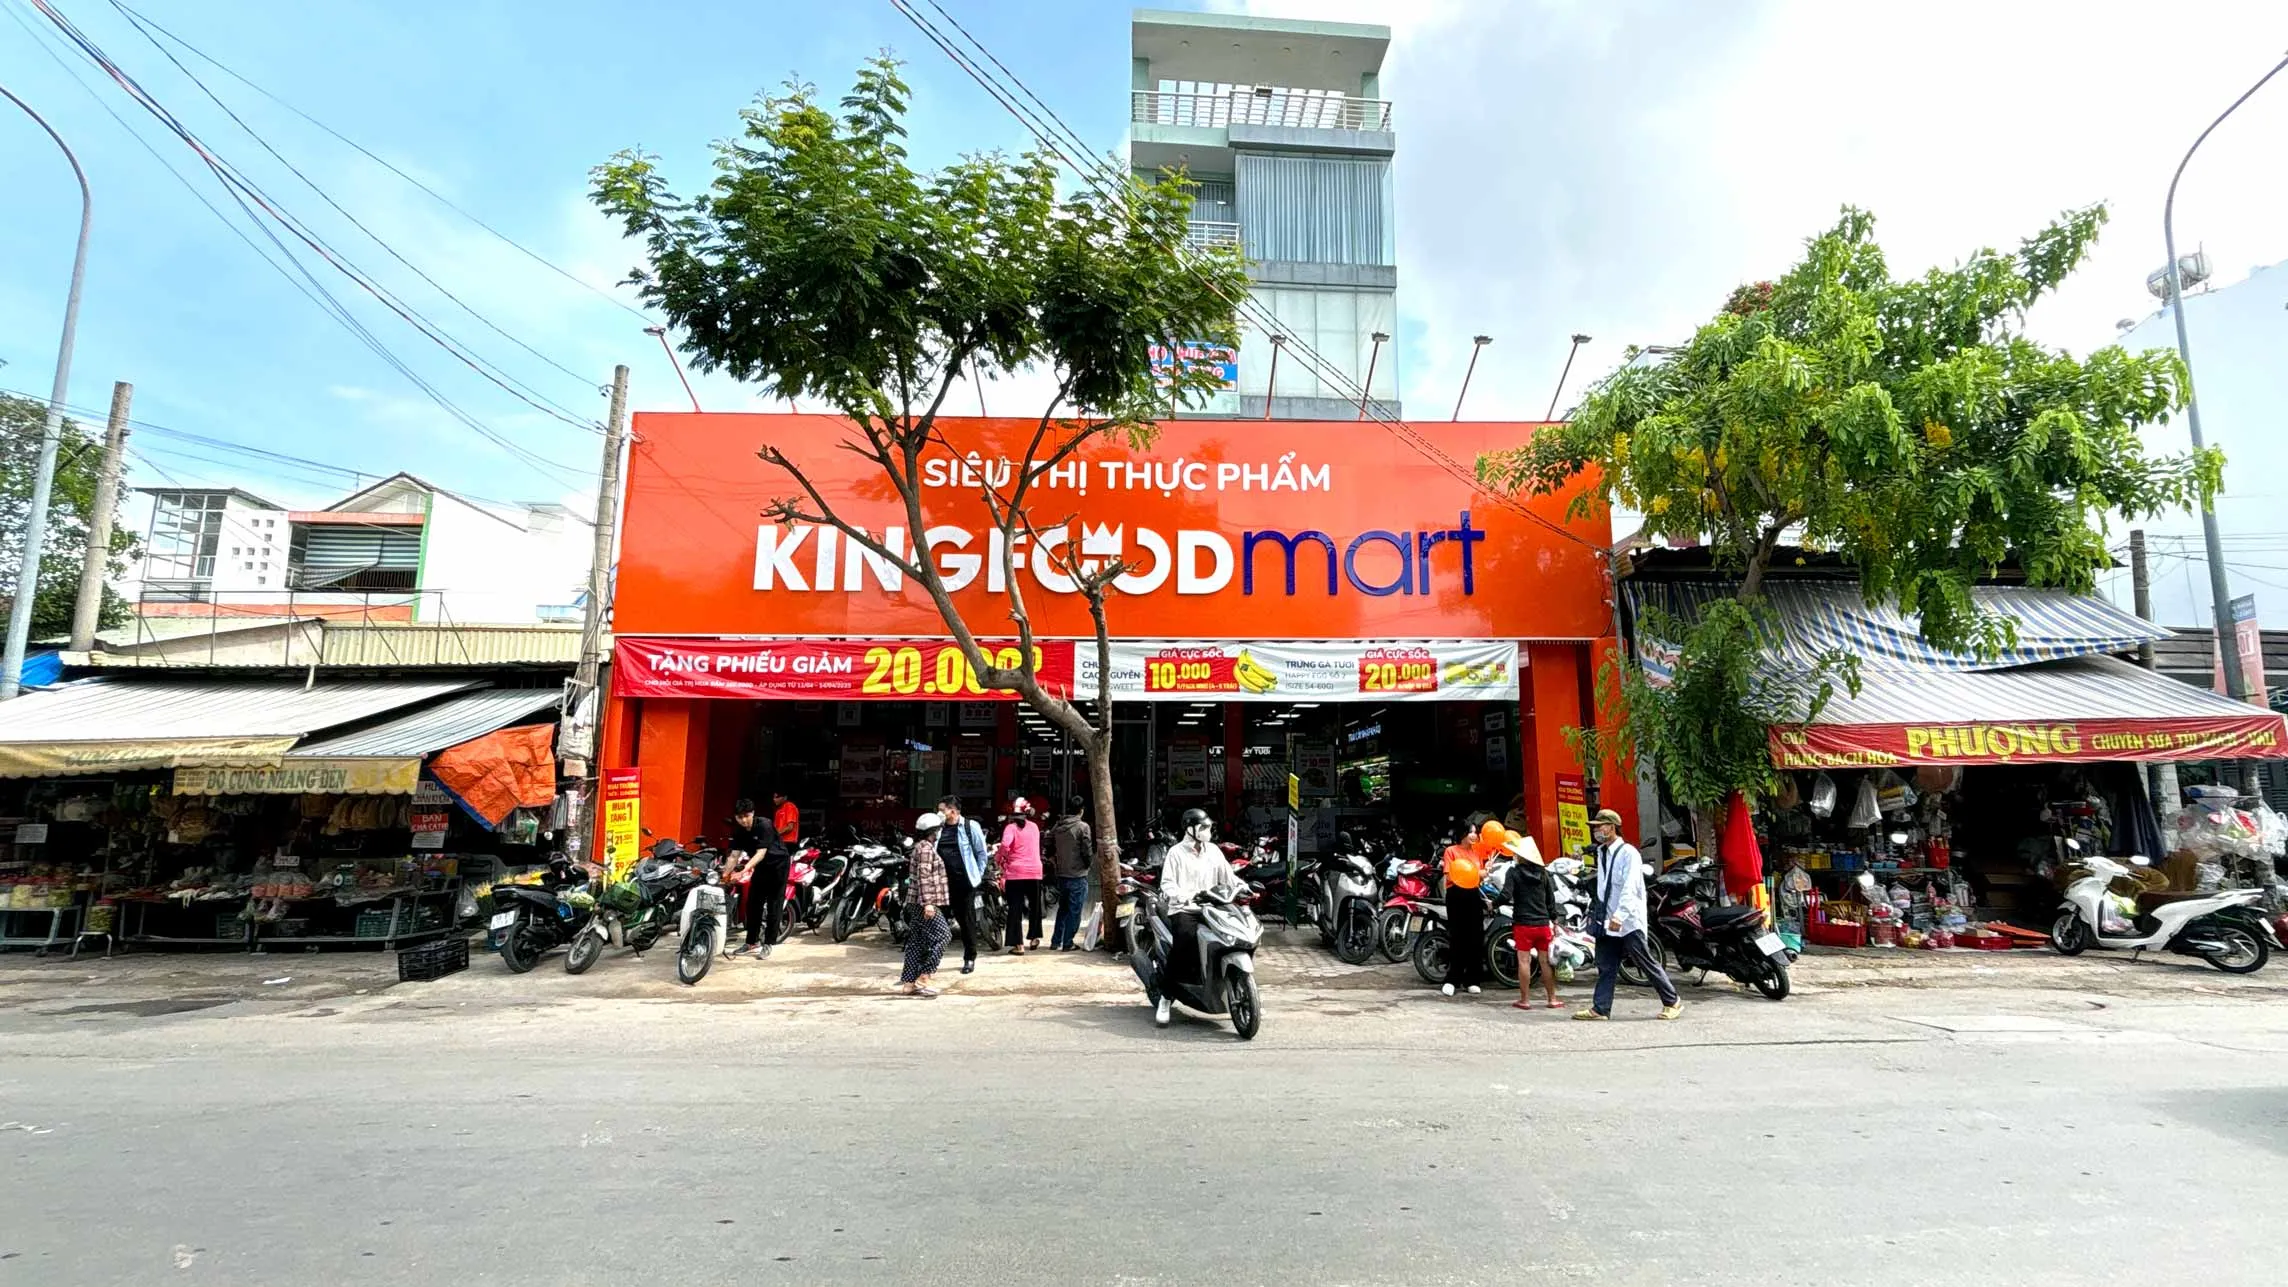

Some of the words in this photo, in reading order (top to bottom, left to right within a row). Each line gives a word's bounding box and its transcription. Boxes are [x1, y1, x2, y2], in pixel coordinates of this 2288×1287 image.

[923, 451, 1011, 487] SIÊU
[1030, 460, 1087, 496] THỊ
[1102, 458, 1207, 497] THỰC
[1217, 451, 1331, 492] PHẨM
[648, 650, 710, 675] TẶNG
[716, 649, 786, 673] PHIẾU
[792, 650, 853, 673] GIẢM
[1110, 669, 1141, 679] GUYÊN
[1149, 663, 1211, 689] 10.000
[1365, 663, 1432, 690] 20.000
[1905, 722, 2081, 761] PHƯỢNG
